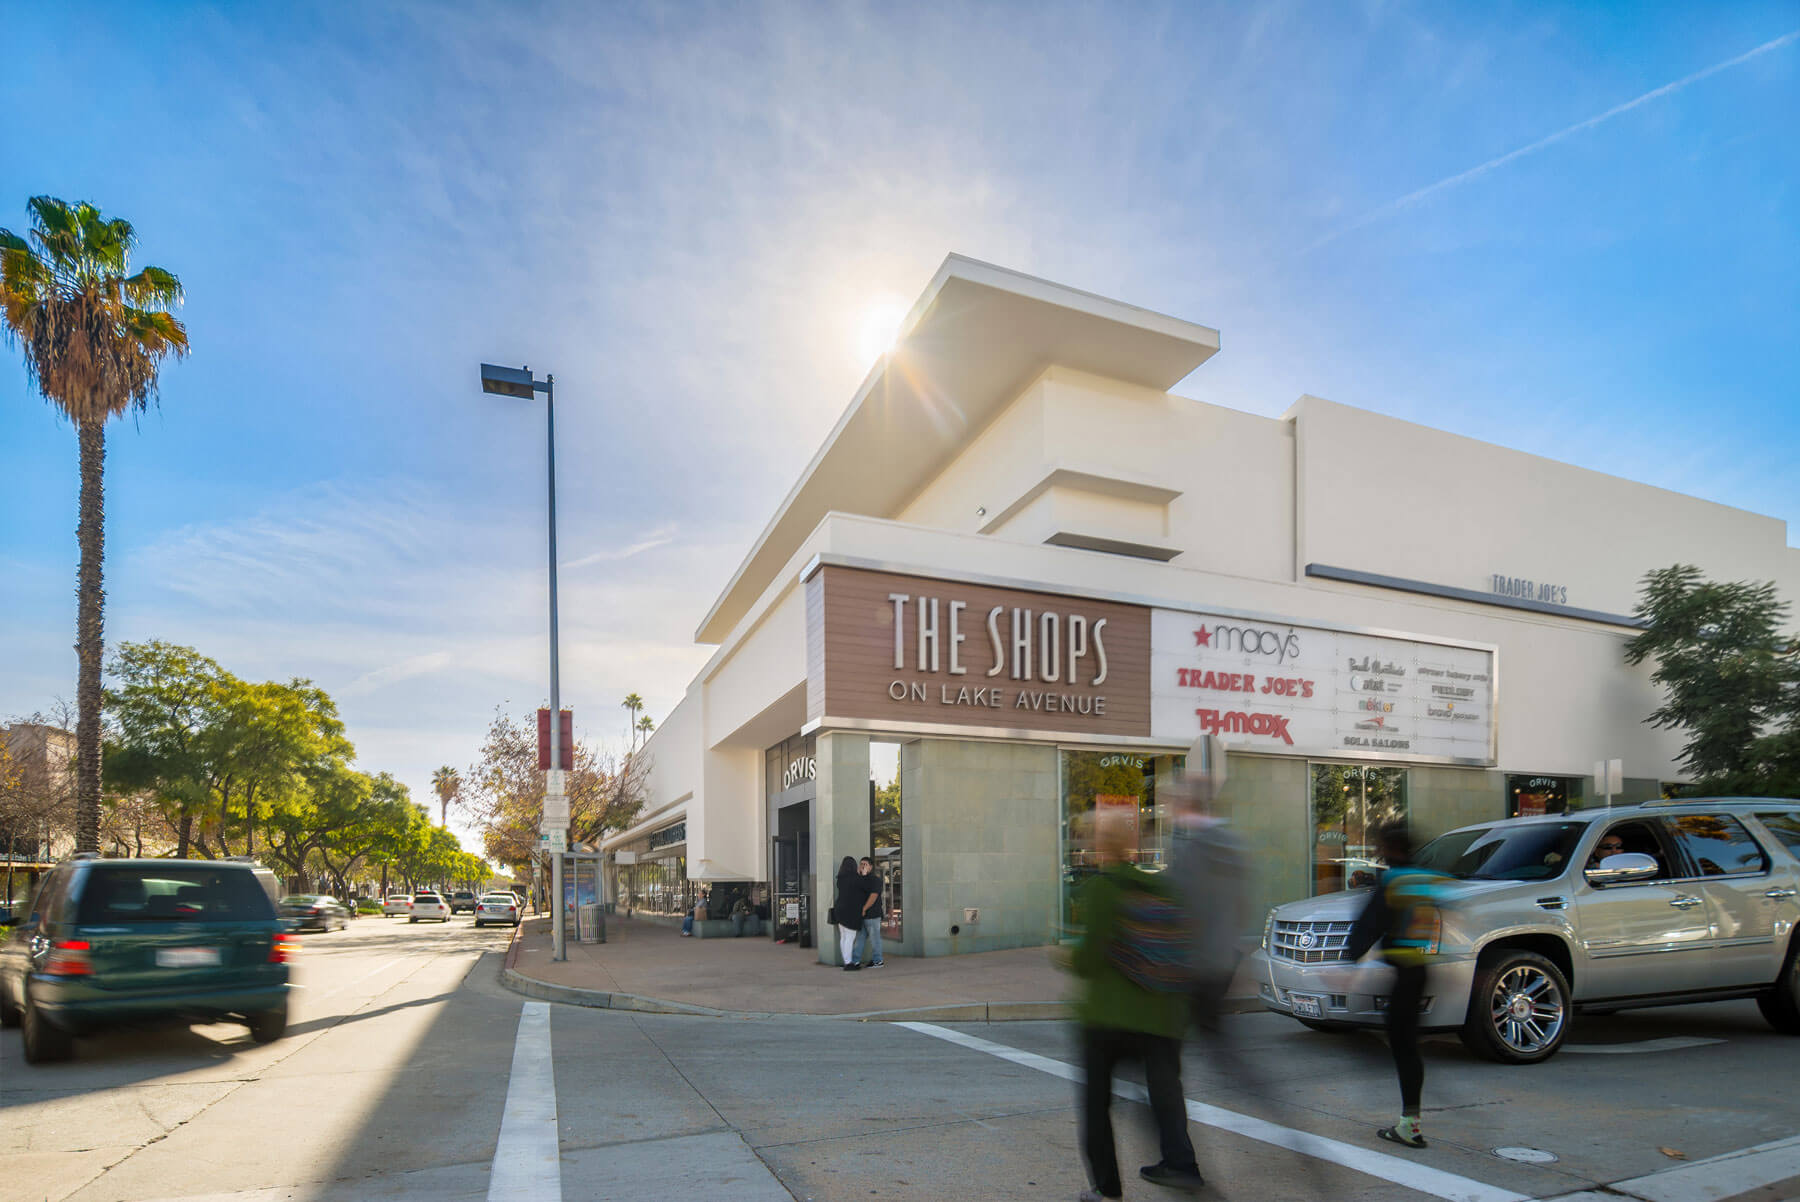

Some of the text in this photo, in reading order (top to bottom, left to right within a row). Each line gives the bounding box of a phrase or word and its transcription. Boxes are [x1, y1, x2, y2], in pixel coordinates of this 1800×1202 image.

[1492, 573, 1568, 604] TRADER JOE'S
[888, 593, 1108, 686] THE SHOPS
[1215, 624, 1300, 664] macy's
[888, 680, 1107, 716] ON LAKE AVENUE
[1177, 667, 1315, 698] TRADER JOE'S
[784, 756, 816, 790] ORVIS
[1100, 755, 1145, 769] ORVIS
[1343, 768, 1377, 780] ORVIS
[1529, 777, 1557, 788] ORVIS
